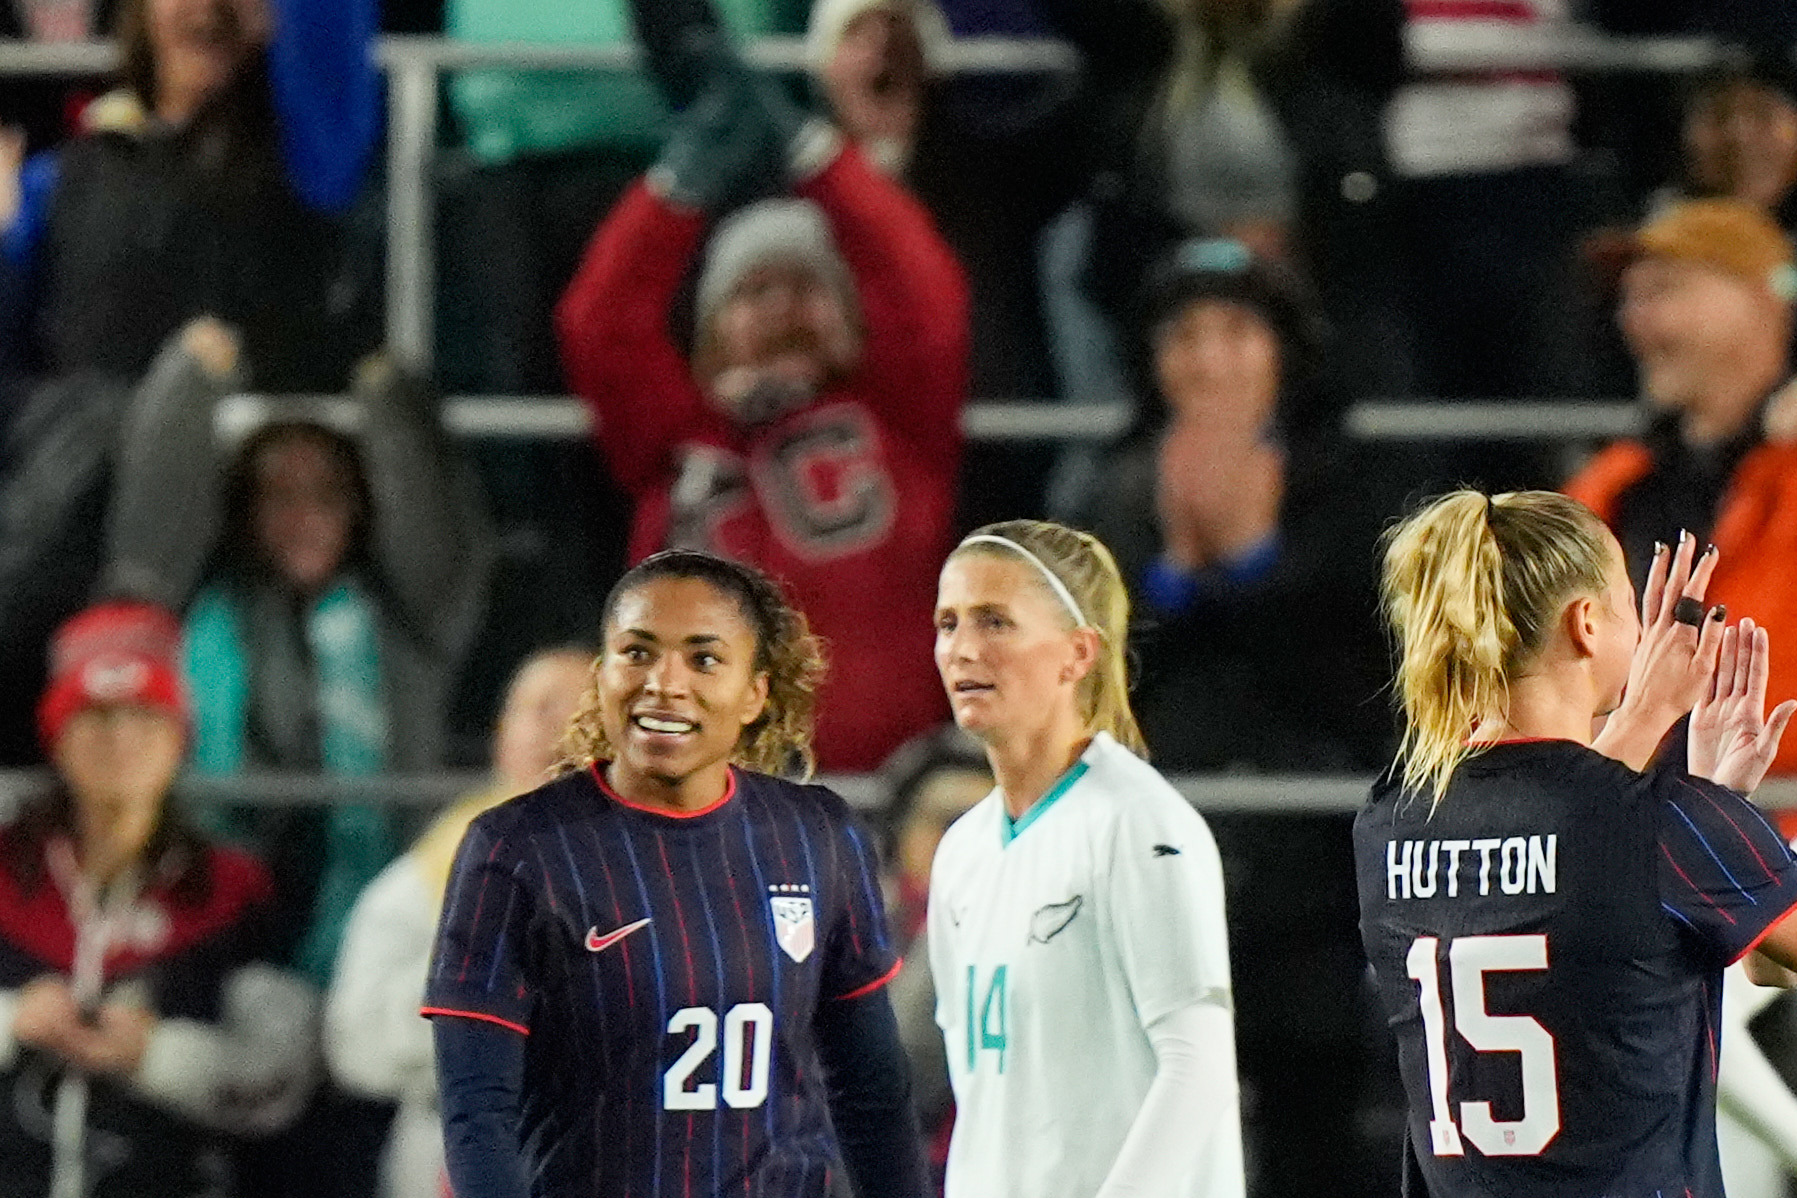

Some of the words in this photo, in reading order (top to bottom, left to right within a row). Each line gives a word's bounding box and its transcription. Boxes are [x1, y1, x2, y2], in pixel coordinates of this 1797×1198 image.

[1387, 834, 1557, 900] HUTTON
[663, 1002, 774, 1110] 20
[967, 964, 1007, 1074] 14
[1405, 934, 1560, 1157] 15
